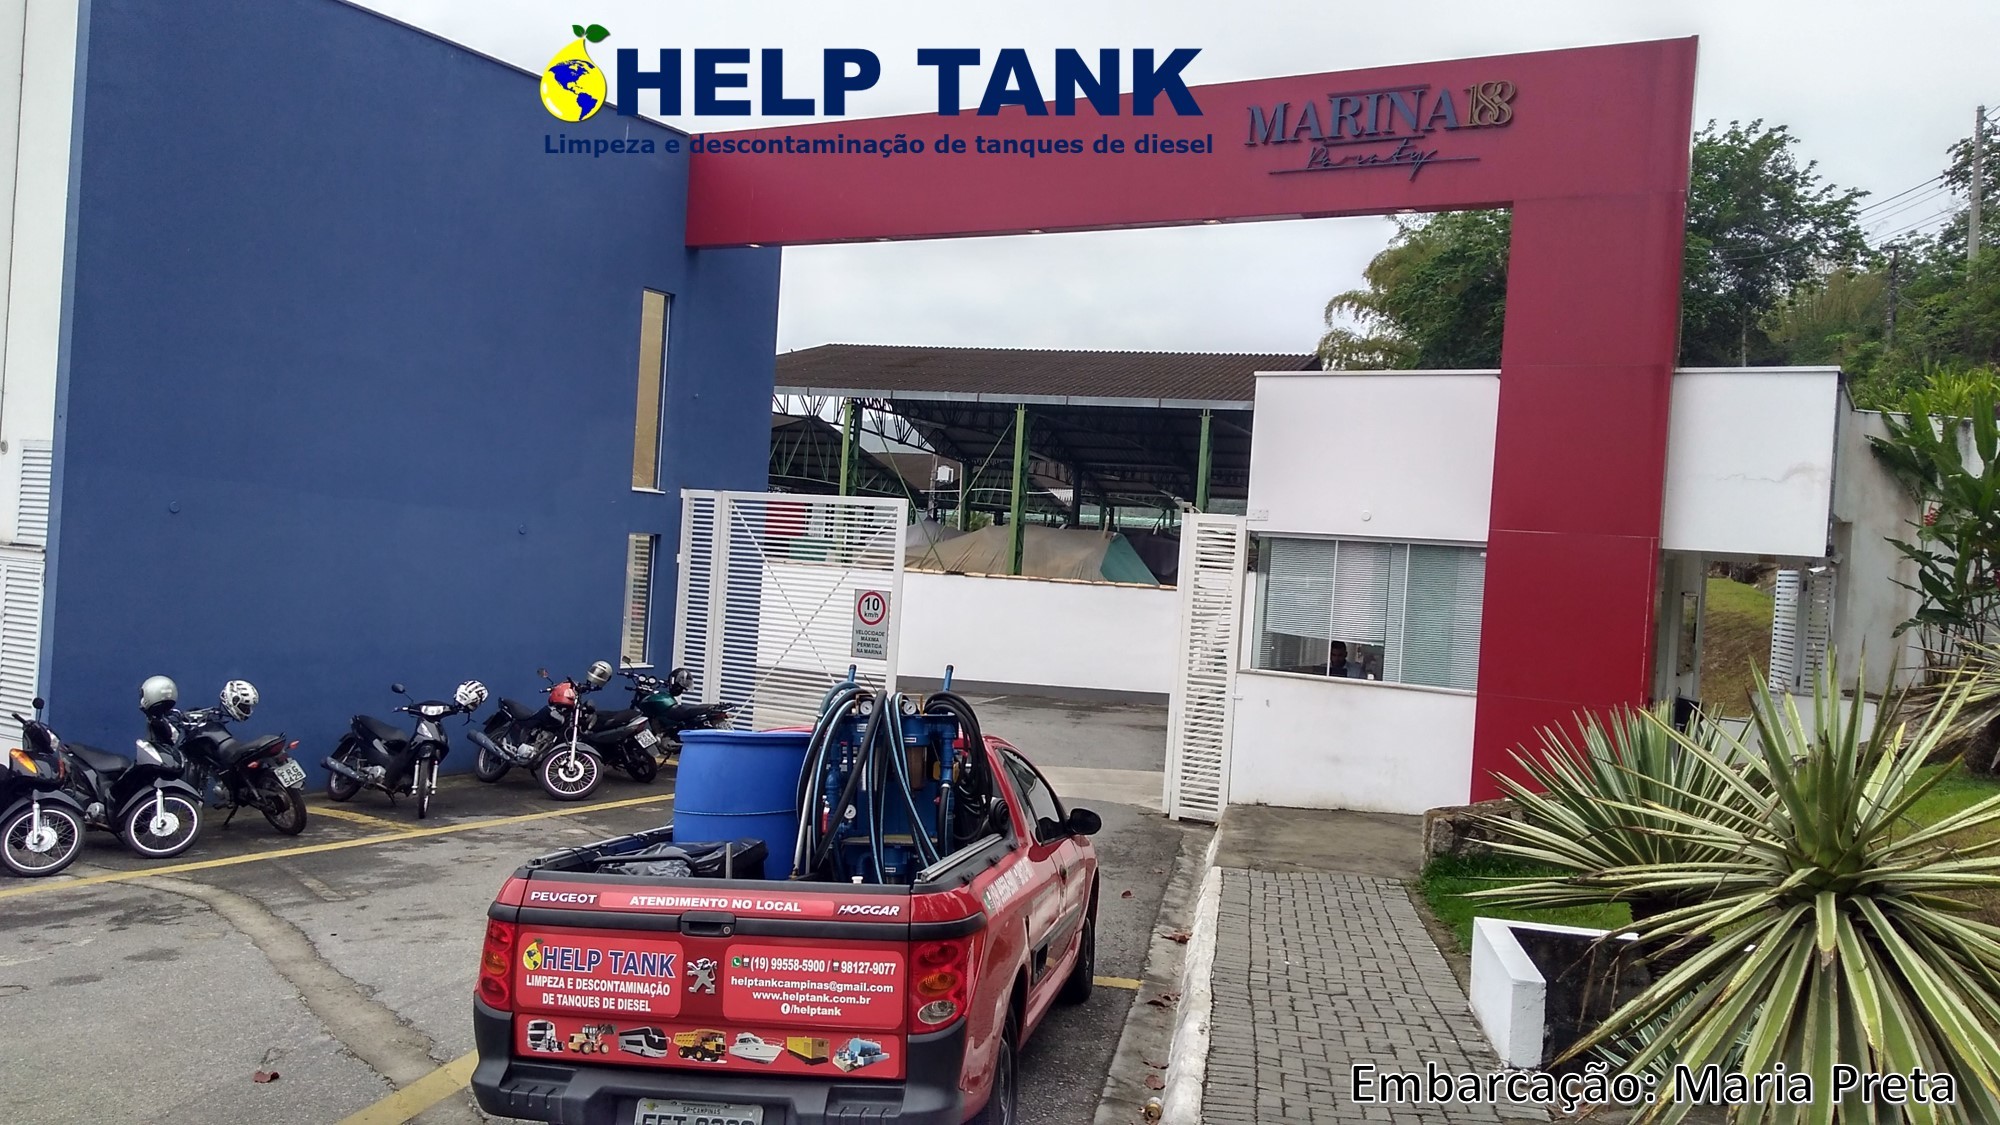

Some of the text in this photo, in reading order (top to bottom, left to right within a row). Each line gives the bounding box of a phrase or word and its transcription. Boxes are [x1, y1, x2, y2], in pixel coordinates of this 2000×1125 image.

[1244, 87, 1459, 147] MARINA
[864, 597, 880, 611] 10
[530, 891, 597, 904] PEUGEOT
[629, 895, 801, 912] ATENDIMENTO NO LOCAL
[837, 904, 900, 916] HOGGAR
[542, 945, 678, 979] HELP TANK
[750, 956, 769, 972] (19)
[771, 957, 825, 973] 99558-5900
[840, 961, 897, 976] 98127-9077
[526, 974, 671, 998] LIMPEZA E DESCONTAMINAÇÃO
[731, 975, 894, 993] helptankcampinas@gmail.com
[542, 993, 651, 1012] DE TANQUES DE DIESEL
[752, 990, 871, 1005] www.helptank.com.br
